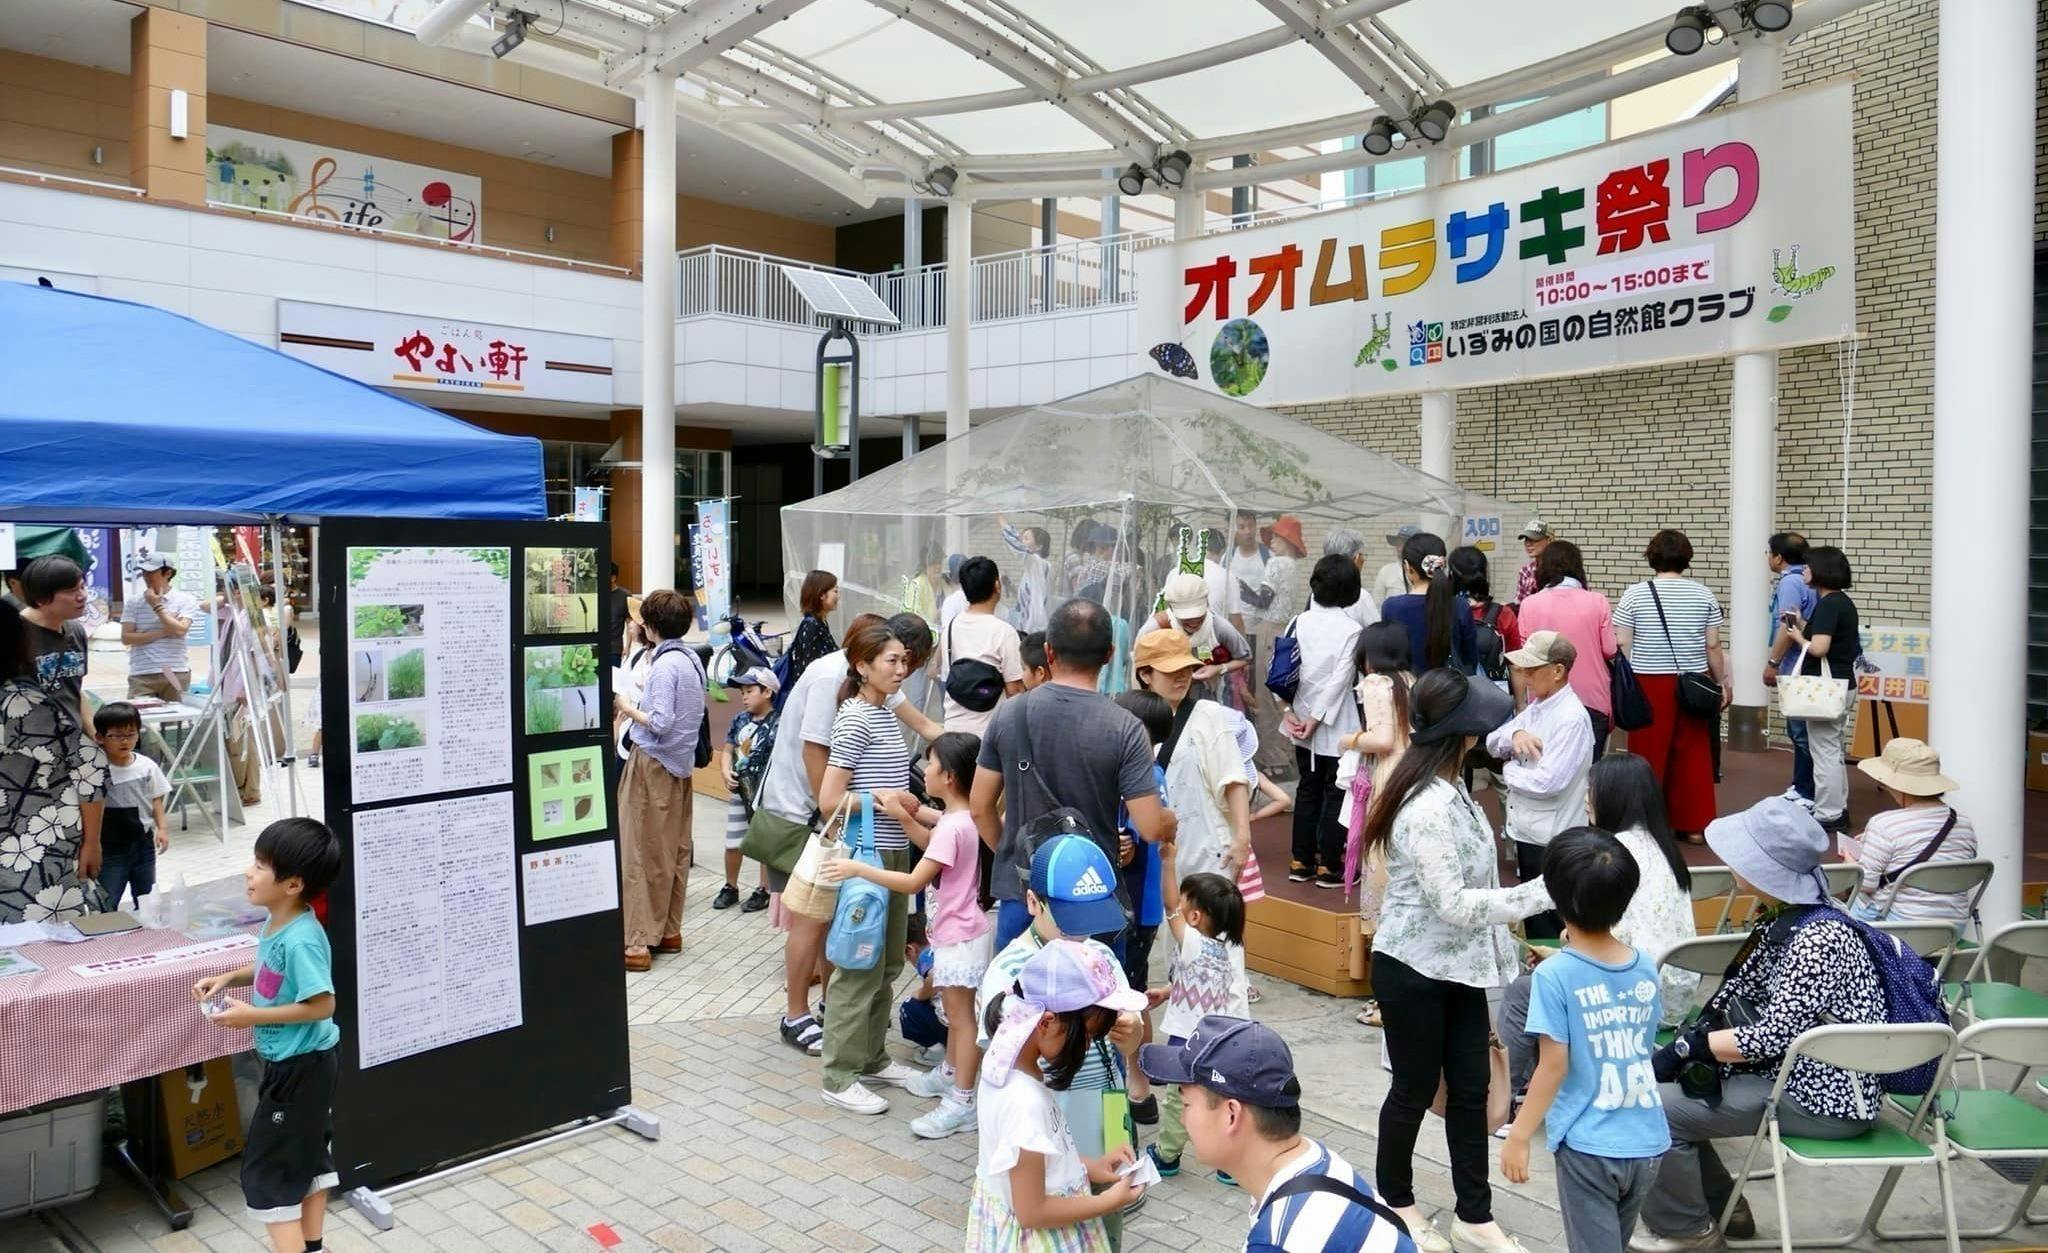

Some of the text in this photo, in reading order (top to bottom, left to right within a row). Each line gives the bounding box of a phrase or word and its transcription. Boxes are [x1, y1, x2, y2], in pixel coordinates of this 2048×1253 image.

[1184, 141, 1760, 325] オオムラサキ祭り
[1535, 270, 1575, 288] 開催時間
[1446, 286, 1756, 359] いずみの国の自然館クラブ
[1450, 308, 1528, 331] 特定非営利活動法人
[394, 330, 528, 381] やよい軒
[1859, 632, 1931, 653] ラサキ
[1072, 883, 1108, 896] adidas
[1574, 983, 1611, 1008] THE
